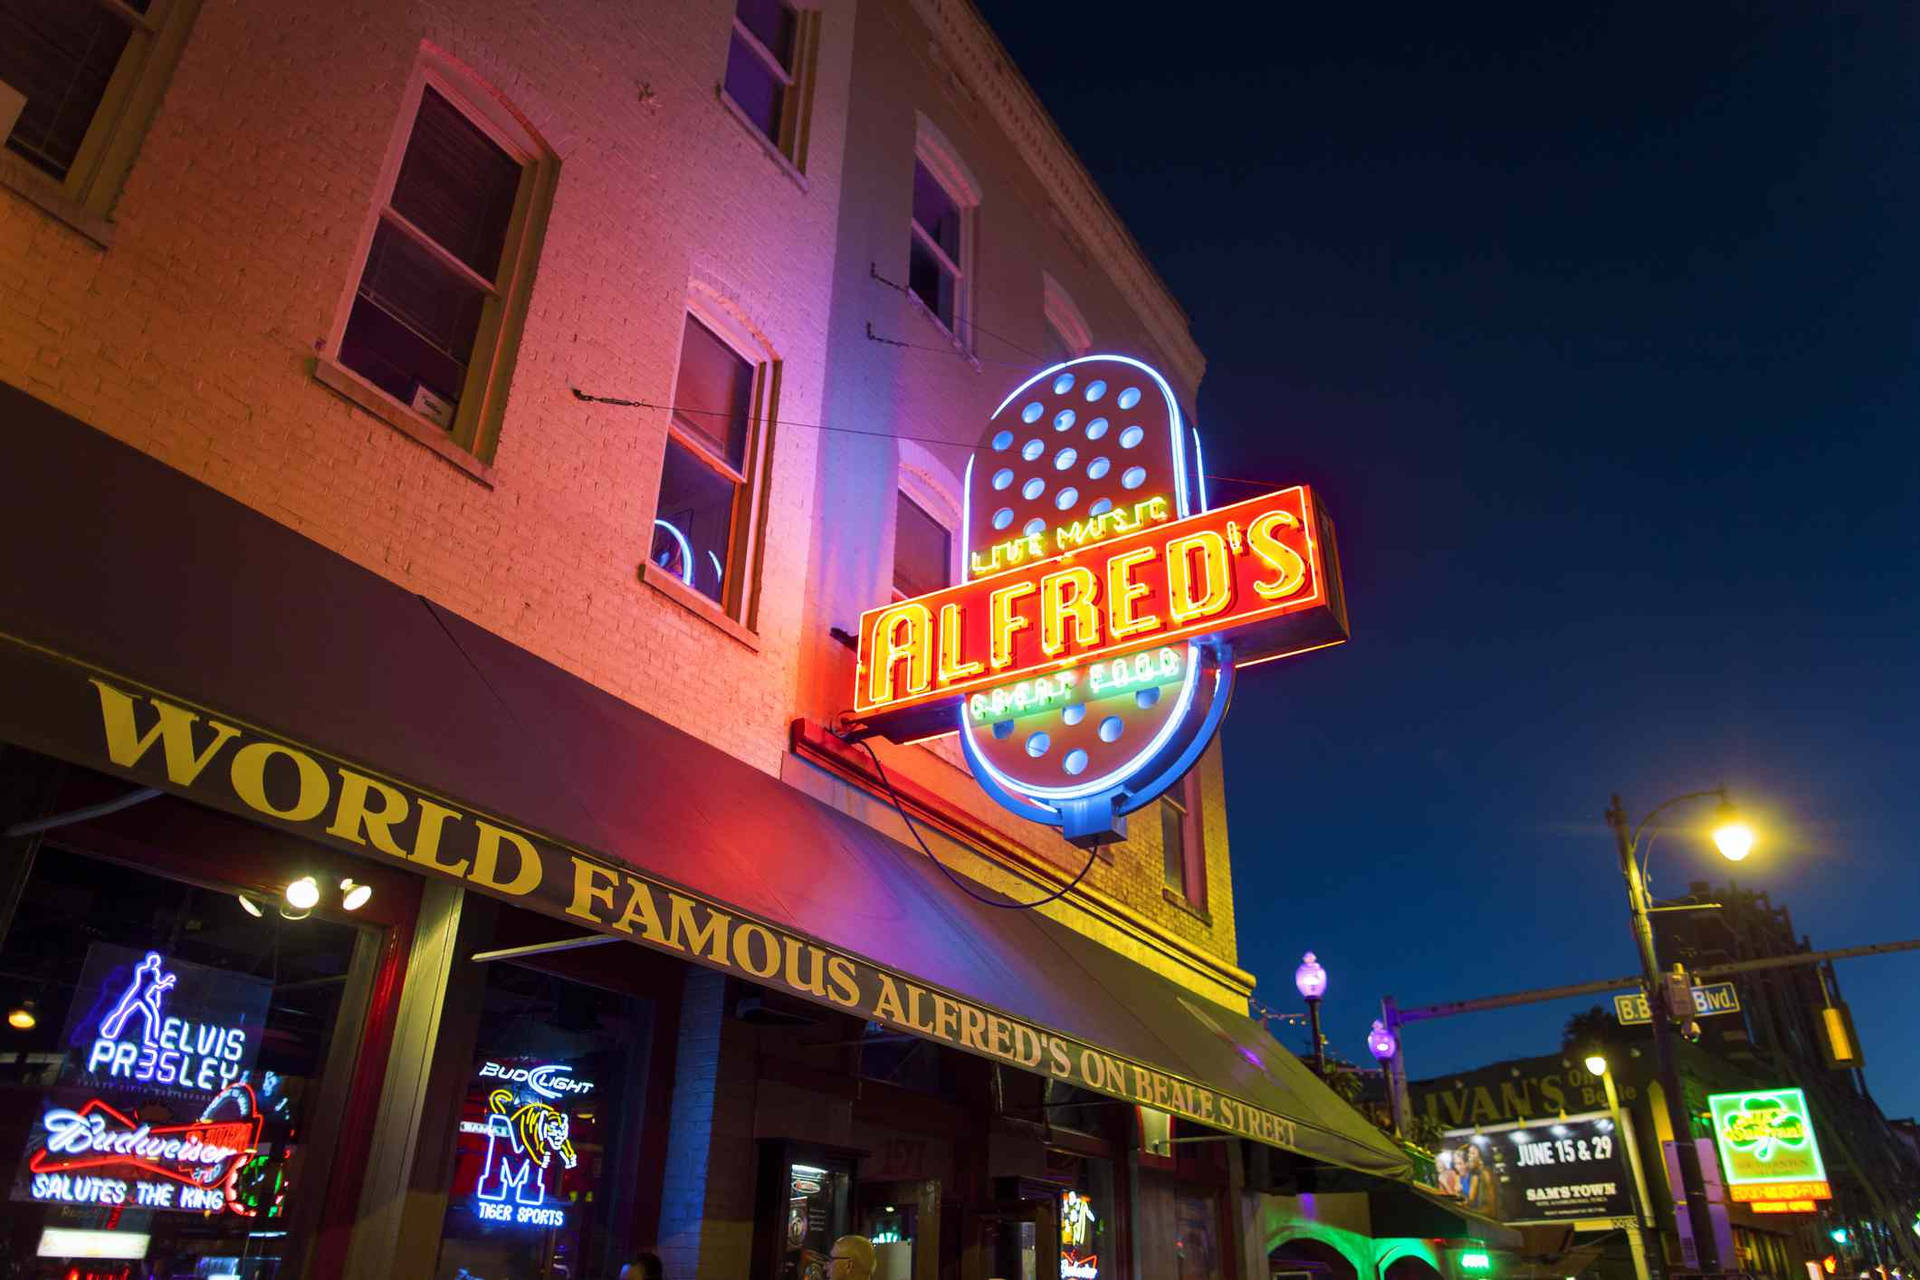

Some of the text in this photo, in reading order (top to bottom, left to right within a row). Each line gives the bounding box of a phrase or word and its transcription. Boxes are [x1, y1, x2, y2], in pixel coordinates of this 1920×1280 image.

[971, 496, 1168, 573] LIVE MUSIC
[868, 510, 1307, 704] ALFRED'S
[1089, 646, 1179, 693] FOOD
[88, 678, 1298, 1148] WORLD FAMOUS ALFRED'S ON BEALE STREET
[159, 1018, 246, 1061] ELVIS
[478, 1062, 595, 1094] BUD LIGHT
[1581, 1085, 1638, 1106] Bele
[43, 1109, 237, 1164] Budweiser
[1517, 1141, 1554, 1168] JUNE
[1555, 1139, 1575, 1163] 15
[1577, 1140, 1592, 1160] &
[1594, 1135, 1613, 1160] 29
[31, 1173, 225, 1211] SALUTES THE KING
[478, 1202, 564, 1226] TIGER SPORTS
